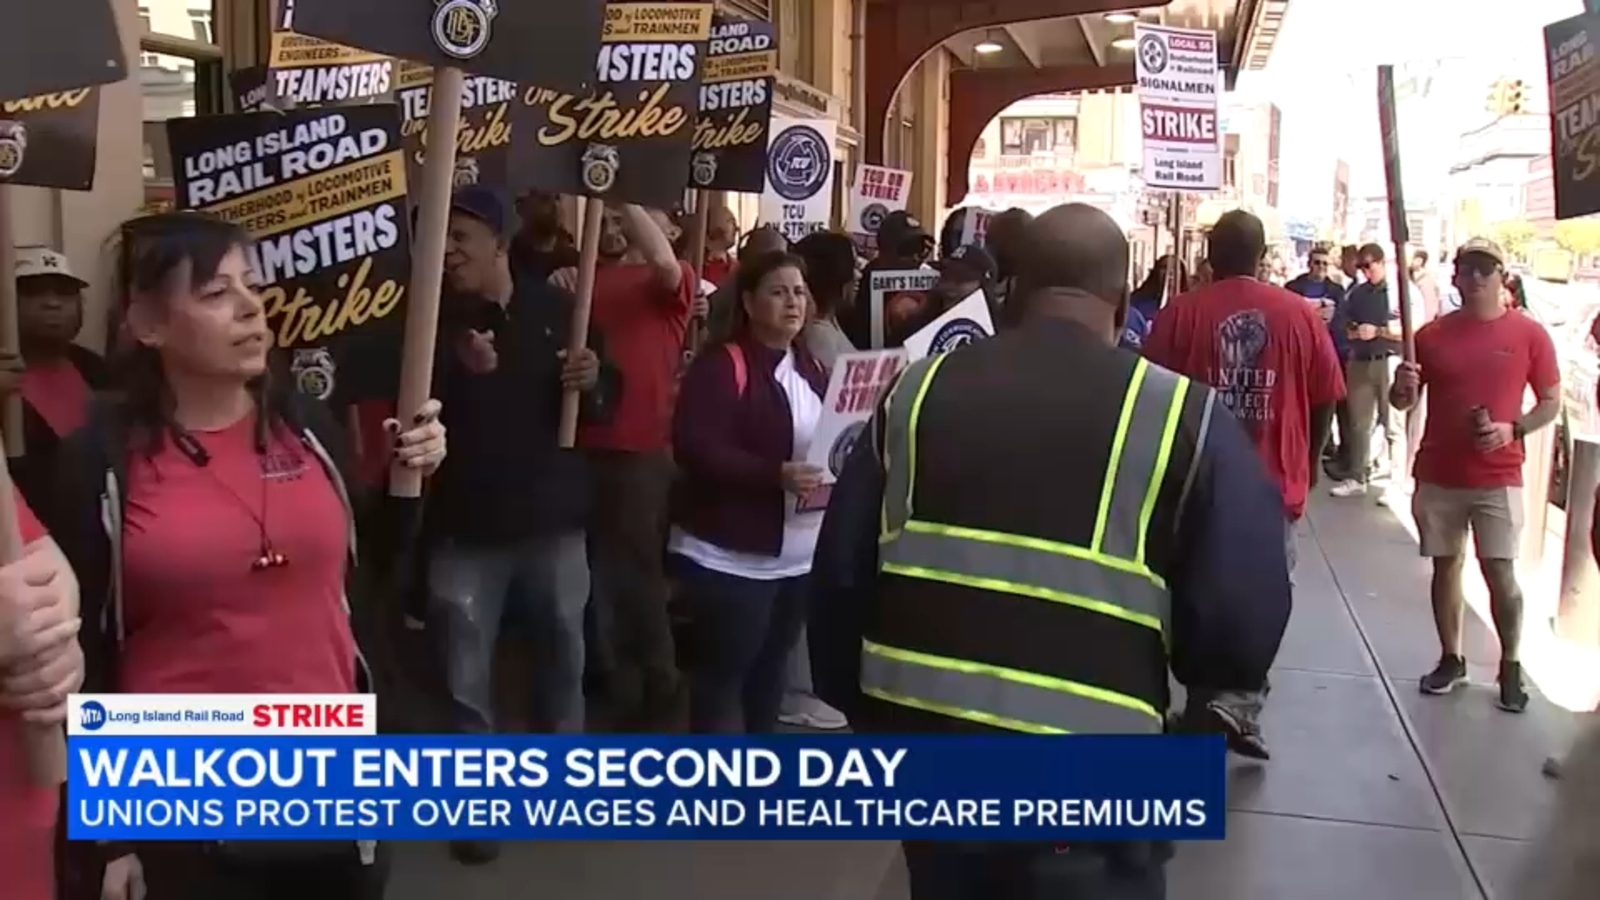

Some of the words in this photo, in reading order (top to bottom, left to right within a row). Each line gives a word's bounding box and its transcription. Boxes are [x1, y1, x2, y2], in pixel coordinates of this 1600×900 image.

[633, 7, 703, 21] LOCOMOTIVE
[632, 22, 701, 35] TRAINMEN
[278, 47, 341, 62] ENGINEERS
[709, 35, 771, 55] ROAD
[275, 61, 393, 103] TEAMSTERS
[1139, 76, 1216, 95] SIGNALMEN
[239, 86, 268, 109] LON
[537, 81, 689, 146] Strike
[1142, 108, 1216, 140] STRIKE
[690, 105, 764, 151] trike
[184, 141, 252, 179] LONG
[256, 114, 346, 157] ISLAND
[188, 162, 275, 208] RAIL
[281, 127, 388, 180] ROAD
[1153, 157, 1175, 170] Long
[1176, 157, 1204, 170] Island
[863, 168, 885, 185] TCU
[887, 172, 904, 188] ON
[1154, 170, 1175, 182] Rail
[1176, 171, 1205, 183] Road
[214, 189, 294, 222] THERHOOD
[307, 159, 392, 196] LOCOMOTIVE
[861, 183, 900, 201] STRIKE
[242, 209, 286, 233] EERS
[309, 177, 393, 214] TRAINMEN
[782, 203, 806, 220] TCU
[872, 275, 906, 291] GARY'S
[842, 358, 879, 387] TCU
[1207, 366, 1277, 388] UNITED
